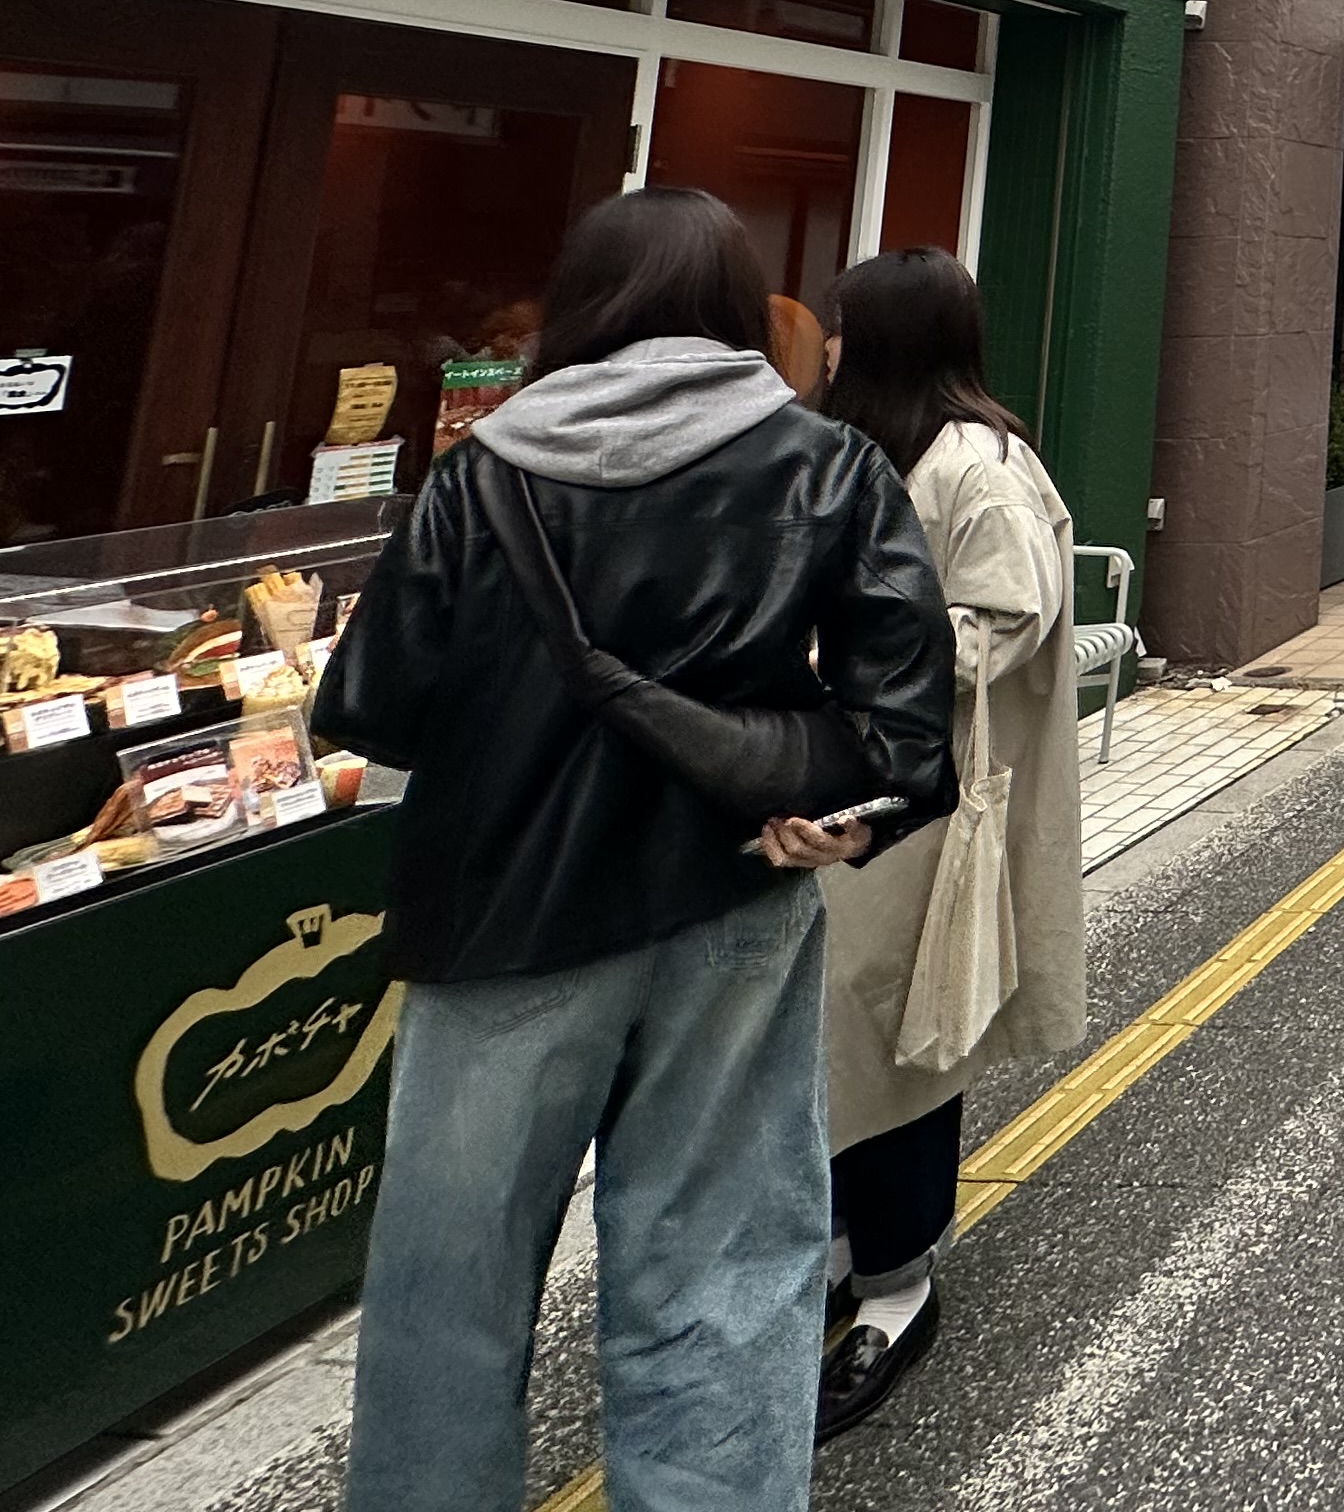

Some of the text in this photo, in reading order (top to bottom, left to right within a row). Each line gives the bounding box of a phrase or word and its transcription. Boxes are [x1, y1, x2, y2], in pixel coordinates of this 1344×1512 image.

[108, 1164, 375, 1345] SWEETS SHOP
[160, 1127, 355, 1263] PAMPKIN
